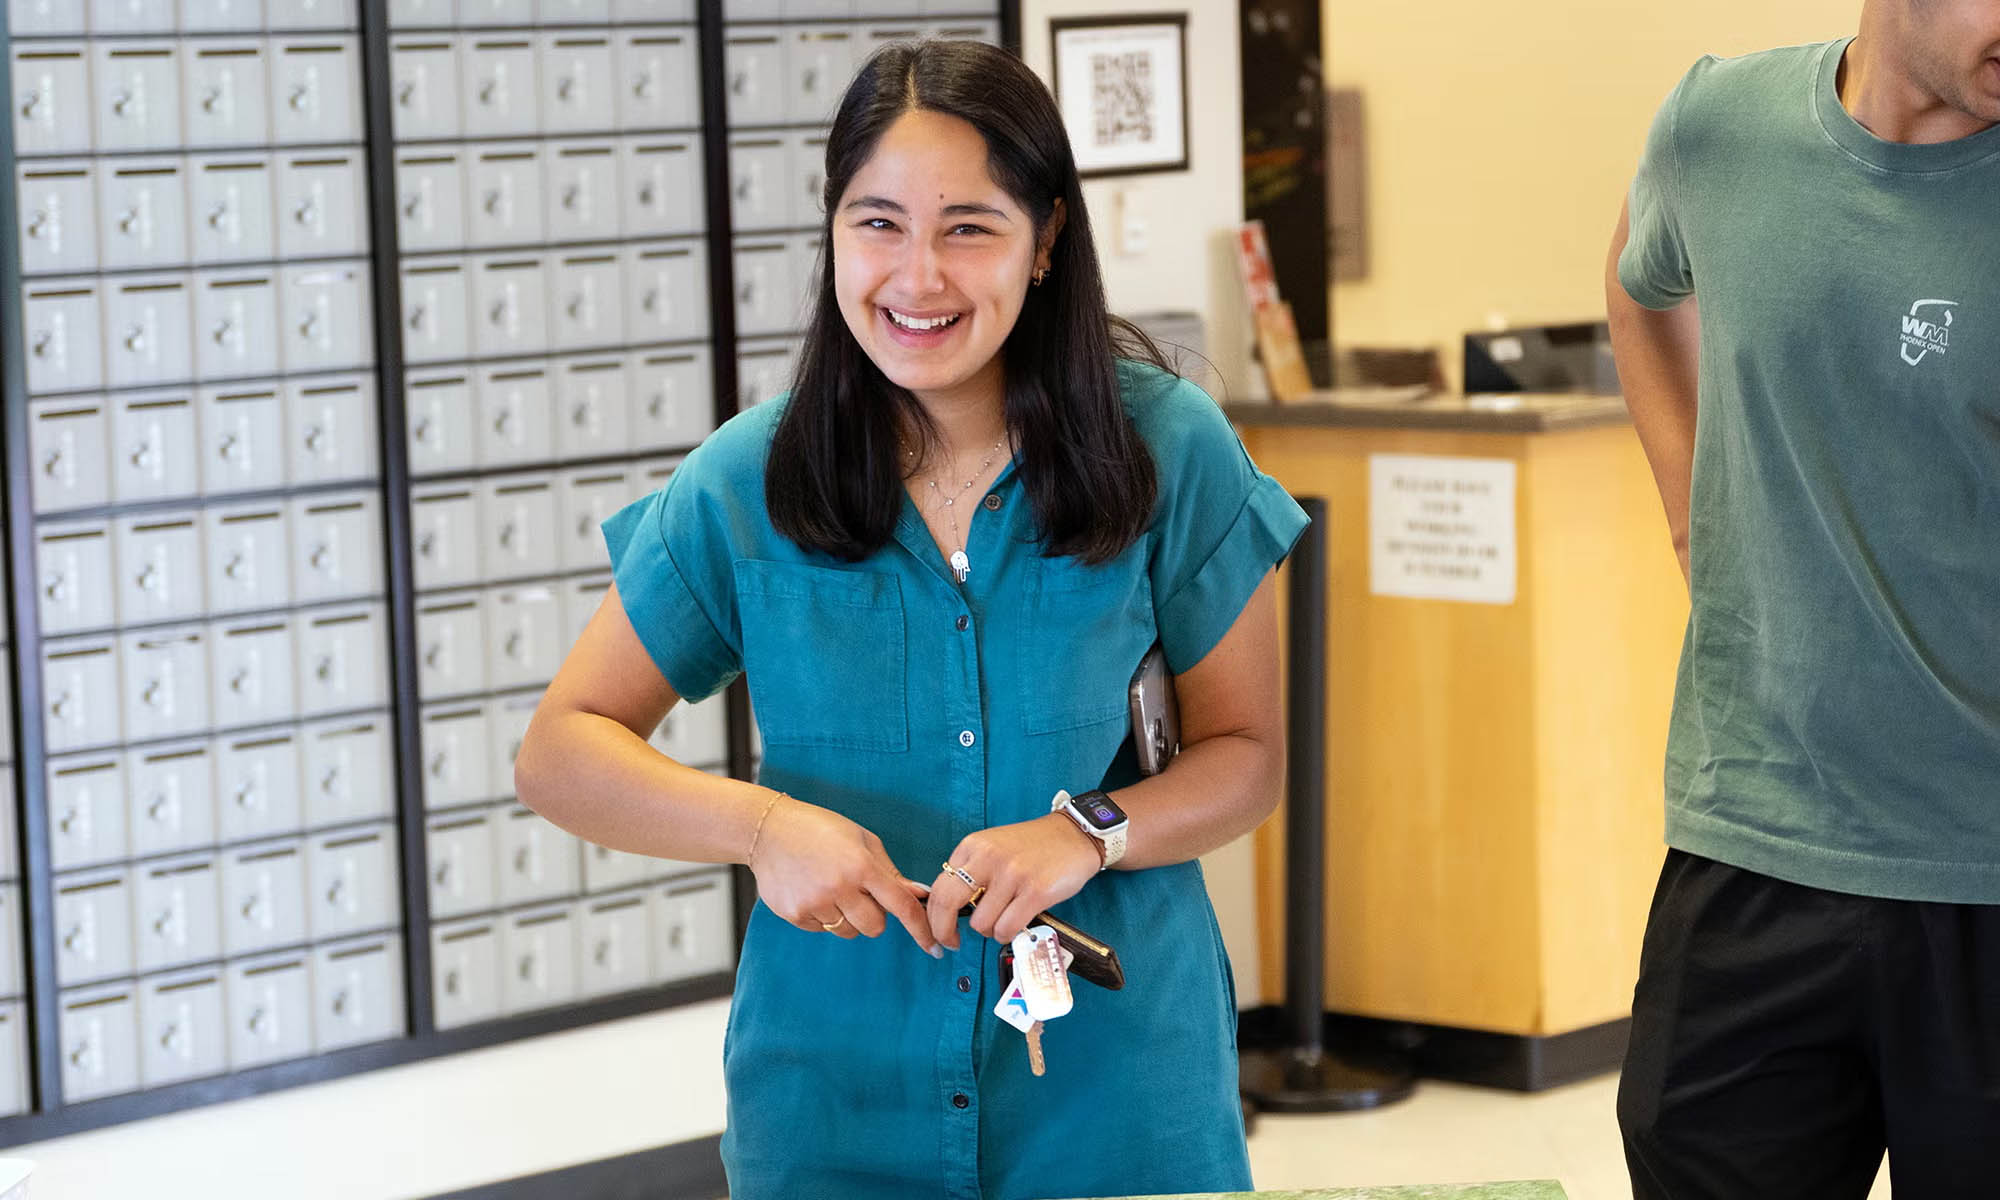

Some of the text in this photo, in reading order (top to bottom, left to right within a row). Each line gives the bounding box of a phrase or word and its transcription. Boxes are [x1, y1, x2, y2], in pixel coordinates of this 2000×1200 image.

[1900, 333, 1946, 354] PHOENIX OPEN
[1902, 315, 1949, 346] WM
